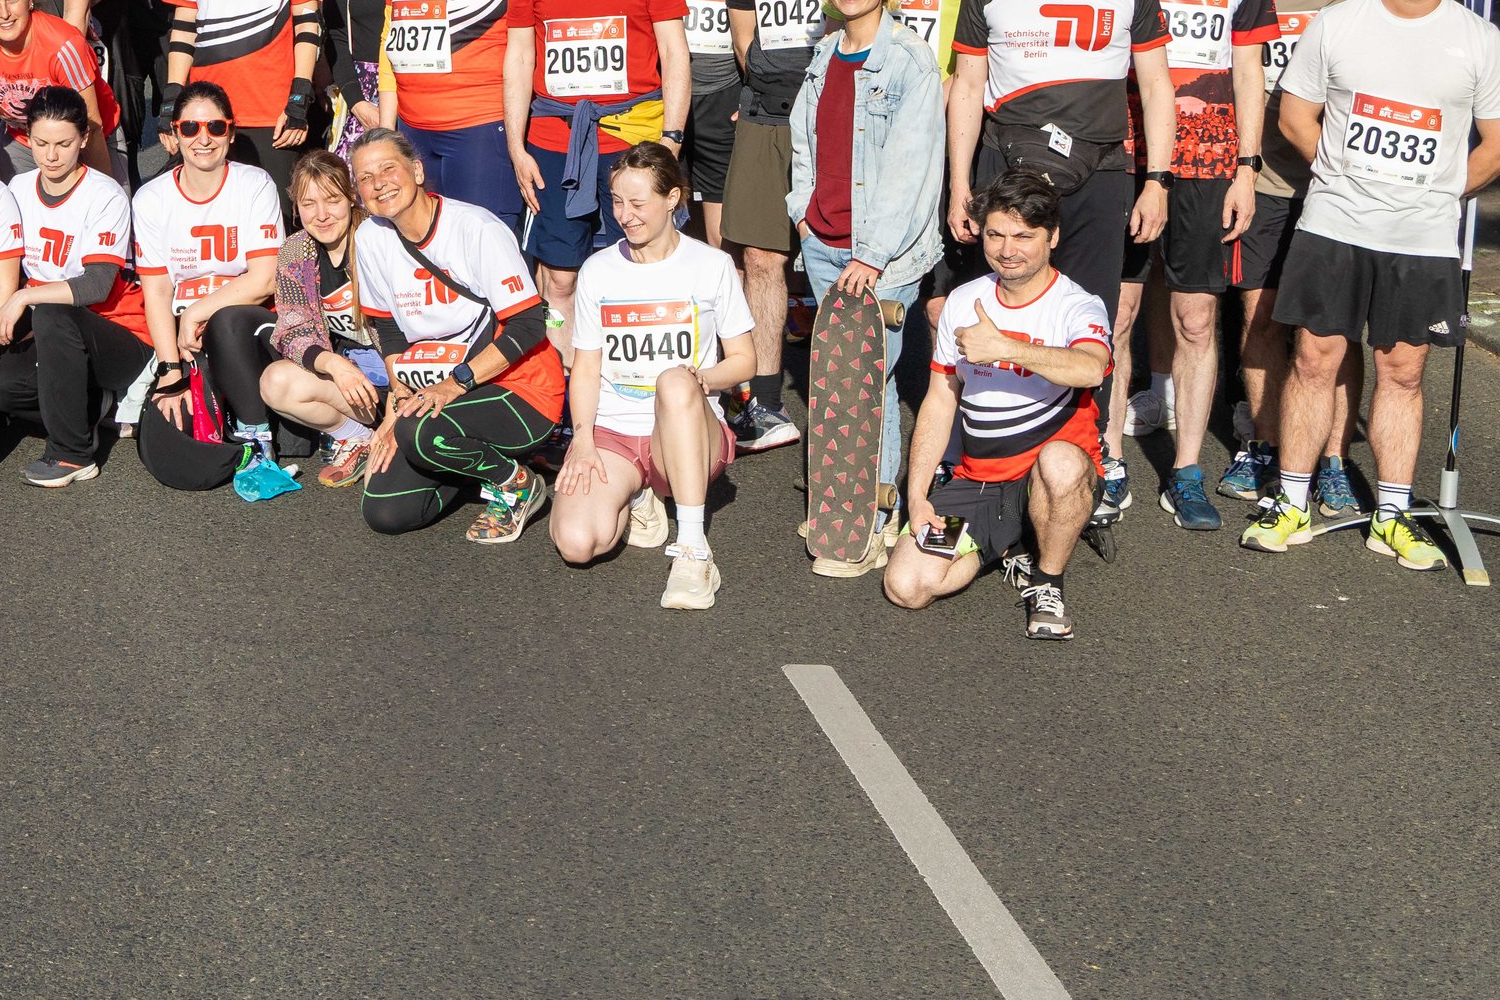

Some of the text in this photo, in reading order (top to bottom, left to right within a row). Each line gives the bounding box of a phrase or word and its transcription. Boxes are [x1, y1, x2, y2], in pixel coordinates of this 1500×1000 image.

[1004, 30, 1050, 38] Technische
[1100, 11, 1112, 37] berlin
[1162, 9, 1225, 41] 0330
[386, 26, 446, 52] 20377
[1004, 39, 1050, 48] Universität
[547, 45, 624, 74] 20509
[1024, 50, 1048, 59] Berlin
[1346, 122, 1438, 166] 20333
[64, 236, 75, 256] berlin
[606, 330, 692, 362] 20440
[397, 370, 454, 390] 2051
[973, 368, 993, 378] Berlin
